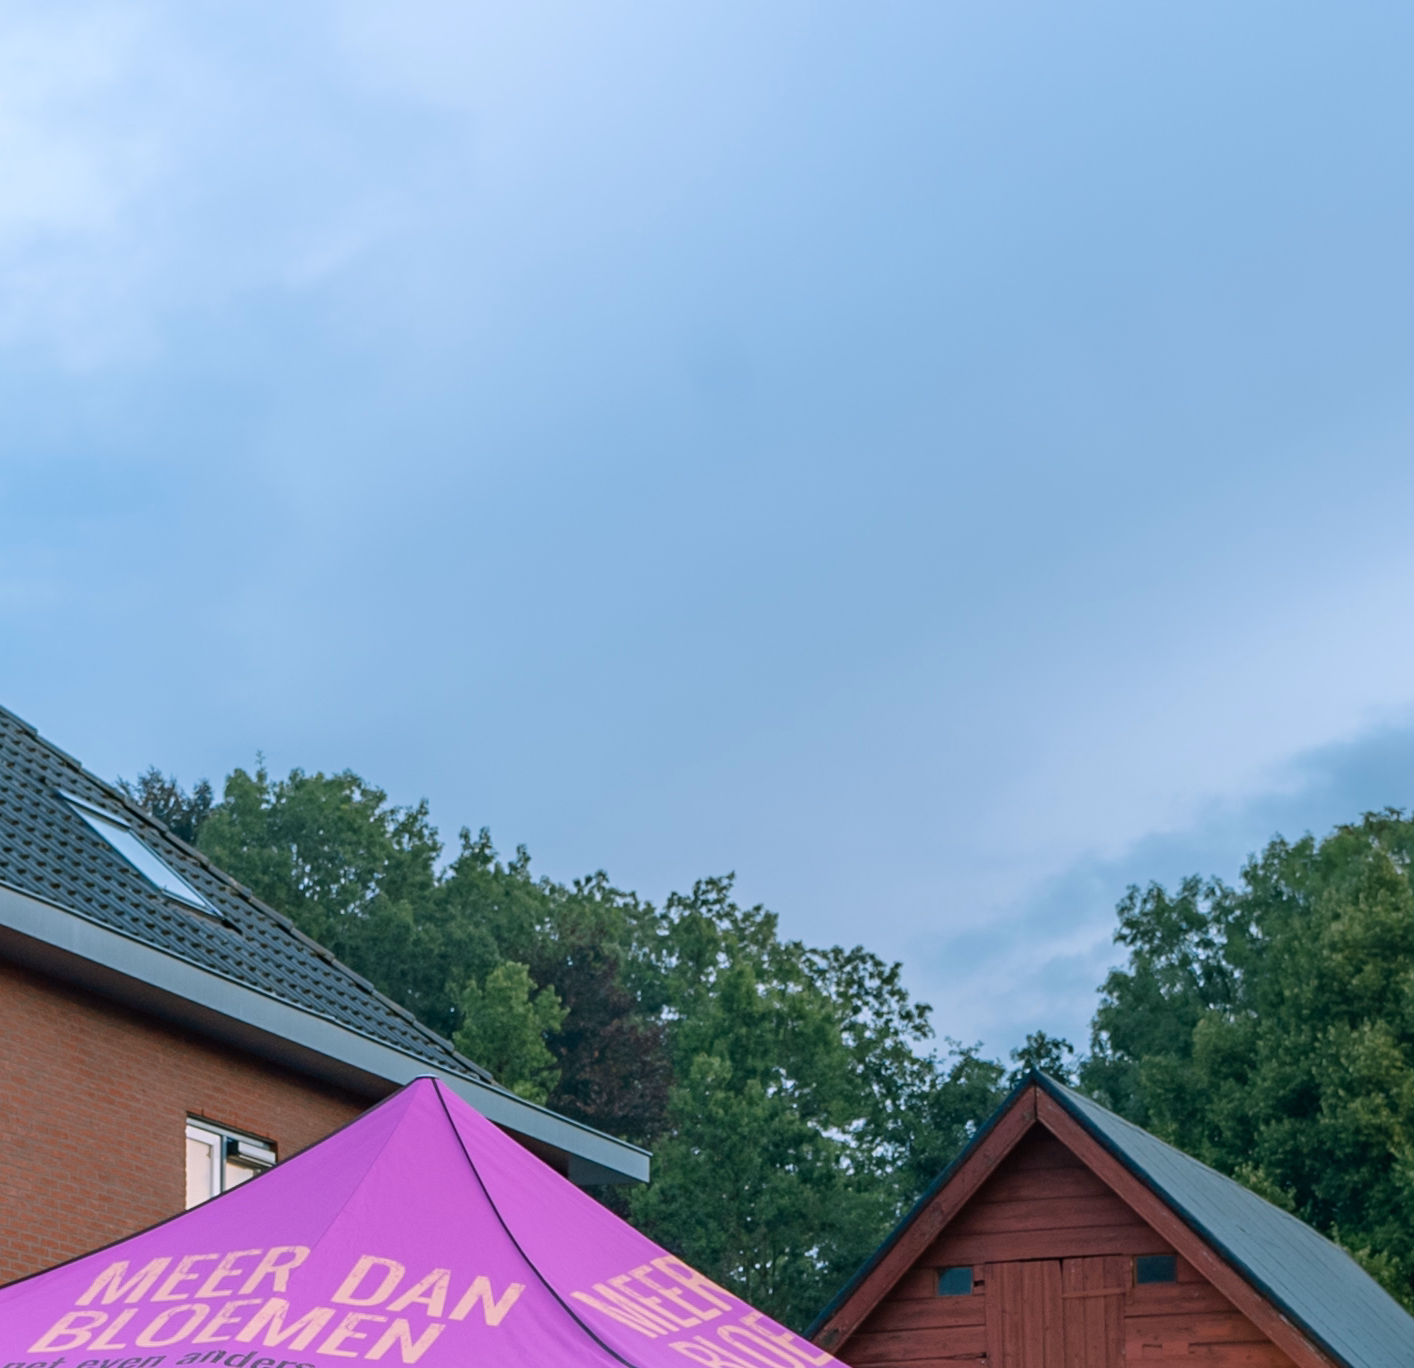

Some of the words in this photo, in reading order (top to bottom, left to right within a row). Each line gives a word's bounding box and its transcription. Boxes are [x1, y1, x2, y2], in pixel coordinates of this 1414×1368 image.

[75, 1245, 311, 1306] MEER
[330, 1254, 526, 1327] DAN
[570, 1255, 733, 1339] MEER
[27, 1297, 446, 1364] BLOEMEN
